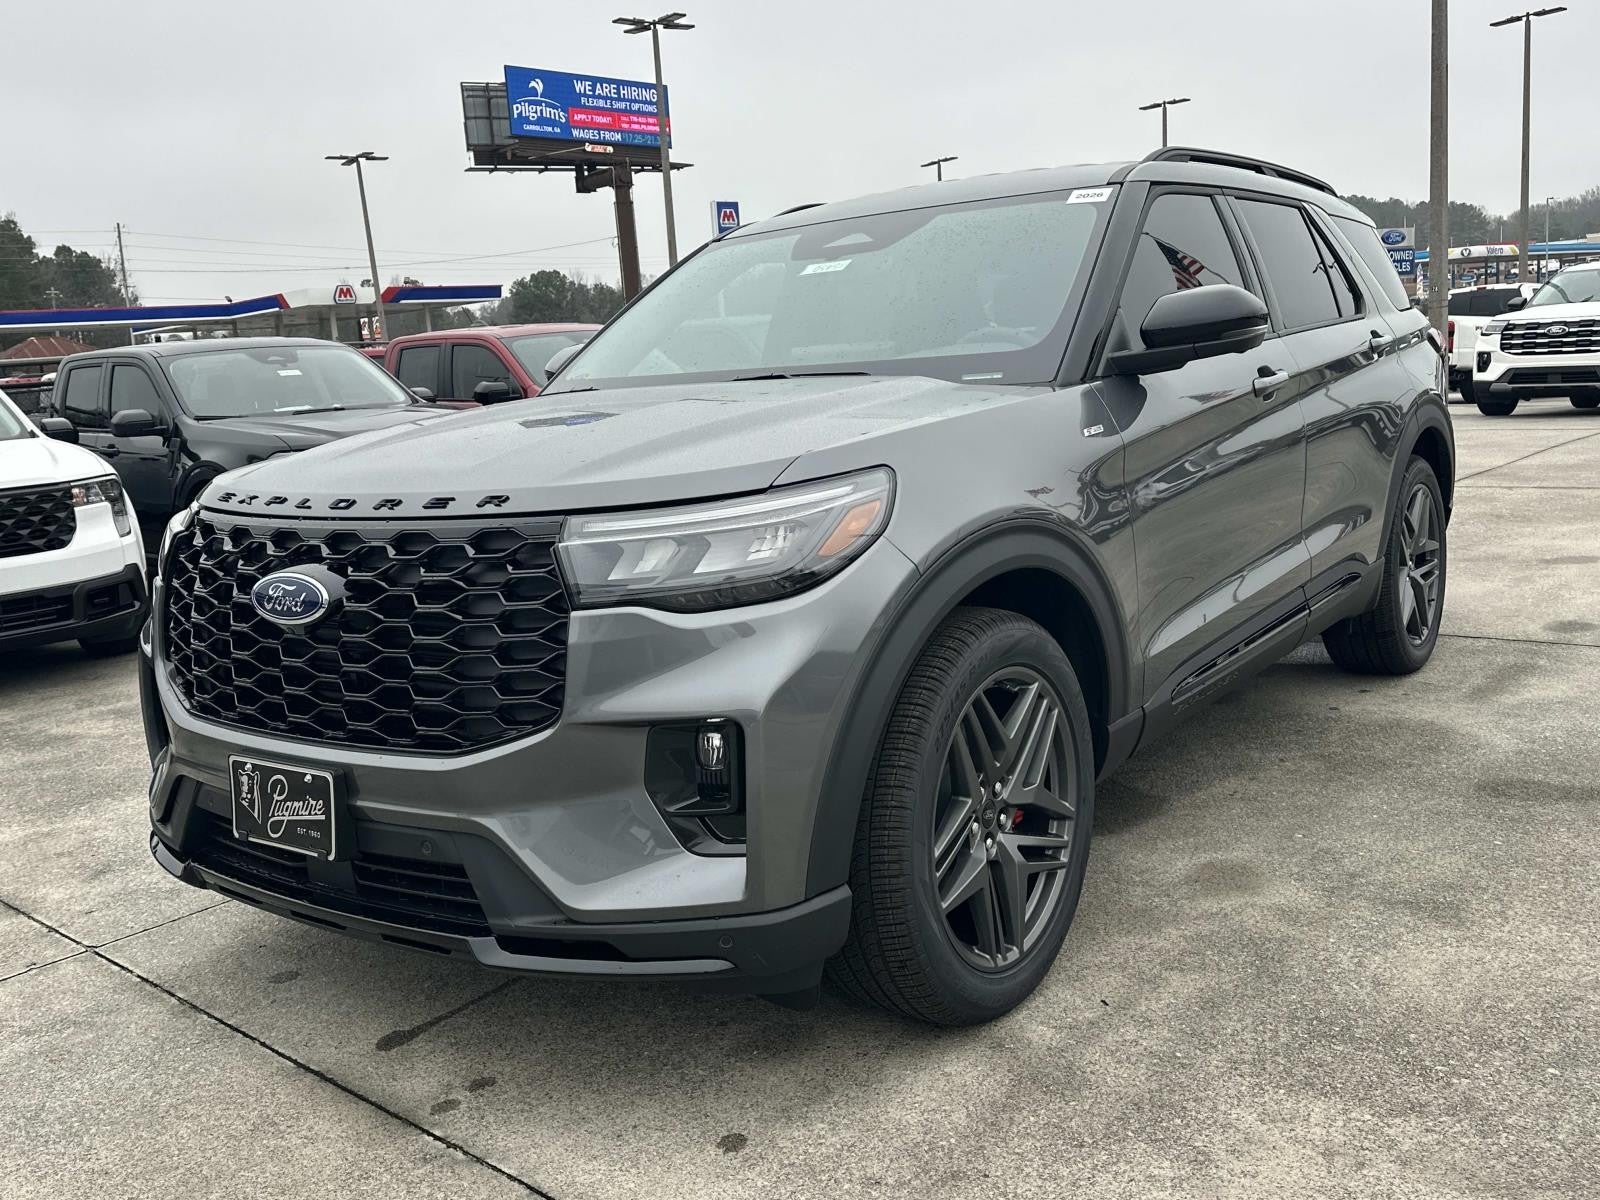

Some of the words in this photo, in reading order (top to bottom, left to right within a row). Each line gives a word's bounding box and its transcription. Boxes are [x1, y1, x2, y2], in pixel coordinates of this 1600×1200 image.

[573, 80, 593, 94] WE
[595, 82, 618, 98] ARE
[620, 85, 657, 102] HIRING
[512, 101, 566, 123] Pilgrim's
[581, 97, 611, 108] FLEXIBLE
[612, 100, 630, 110] SHIFT
[631, 102, 657, 113] OPTIONS
[573, 113, 591, 122] APPLY
[571, 128, 599, 139] WAGES
[600, 131, 622, 142] FROM
[1486, 246, 1504, 255] Valero
[217, 493, 511, 511] EXPLORER
[264, 582, 307, 612] Ford
[267, 774, 325, 838] Pugmire
